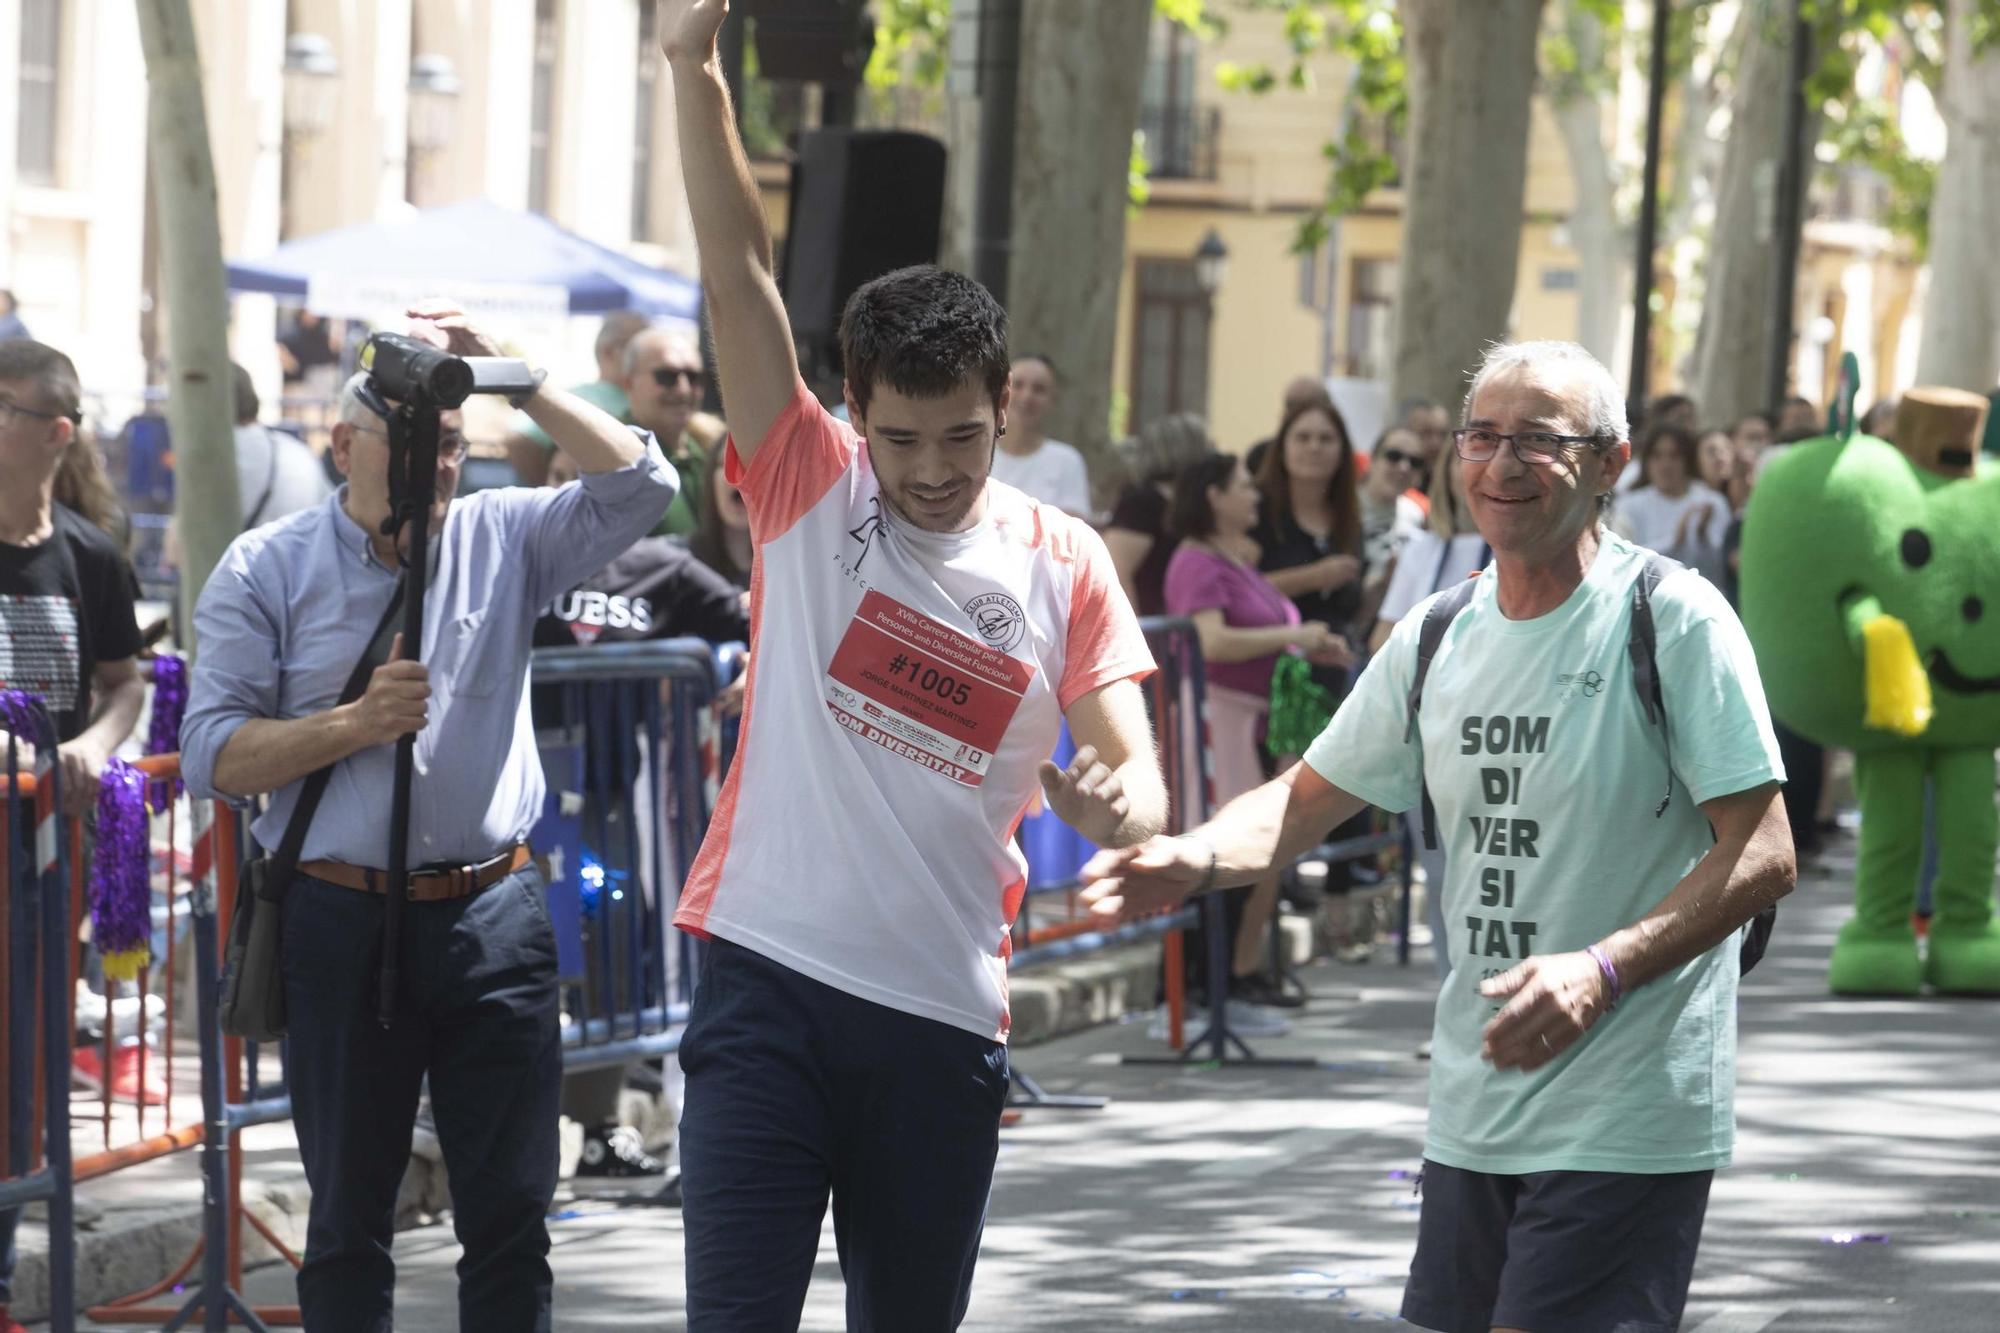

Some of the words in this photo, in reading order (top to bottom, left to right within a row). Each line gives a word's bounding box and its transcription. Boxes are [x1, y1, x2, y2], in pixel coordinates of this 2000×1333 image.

[539, 590, 653, 632] UESS
[966, 599, 984, 615] CLUB
[986, 596, 1023, 623] ATLETISMO
[876, 611, 914, 638] Persones
[914, 633, 932, 646] amb
[932, 639, 972, 666] Diversitat
[972, 660, 1013, 683] Funcional
[919, 619, 949, 640] Carrera
[949, 633, 982, 656] Popular
[982, 649, 998, 663] per
[997, 657, 1004, 665] a
[859, 670, 889, 689] JORGE
[891, 684, 935, 710] MARTINEZ
[935, 705, 978, 730] MARTINEZ
[889, 654, 972, 706] #1005
[866, 729, 966, 780] DIVERSITAT
[1460, 715, 1551, 756] SOM
[1481, 767, 1521, 805] DI
[1469, 816, 1540, 858] VER
[1480, 866, 1516, 908] SI
[1465, 916, 1538, 960] TAT
